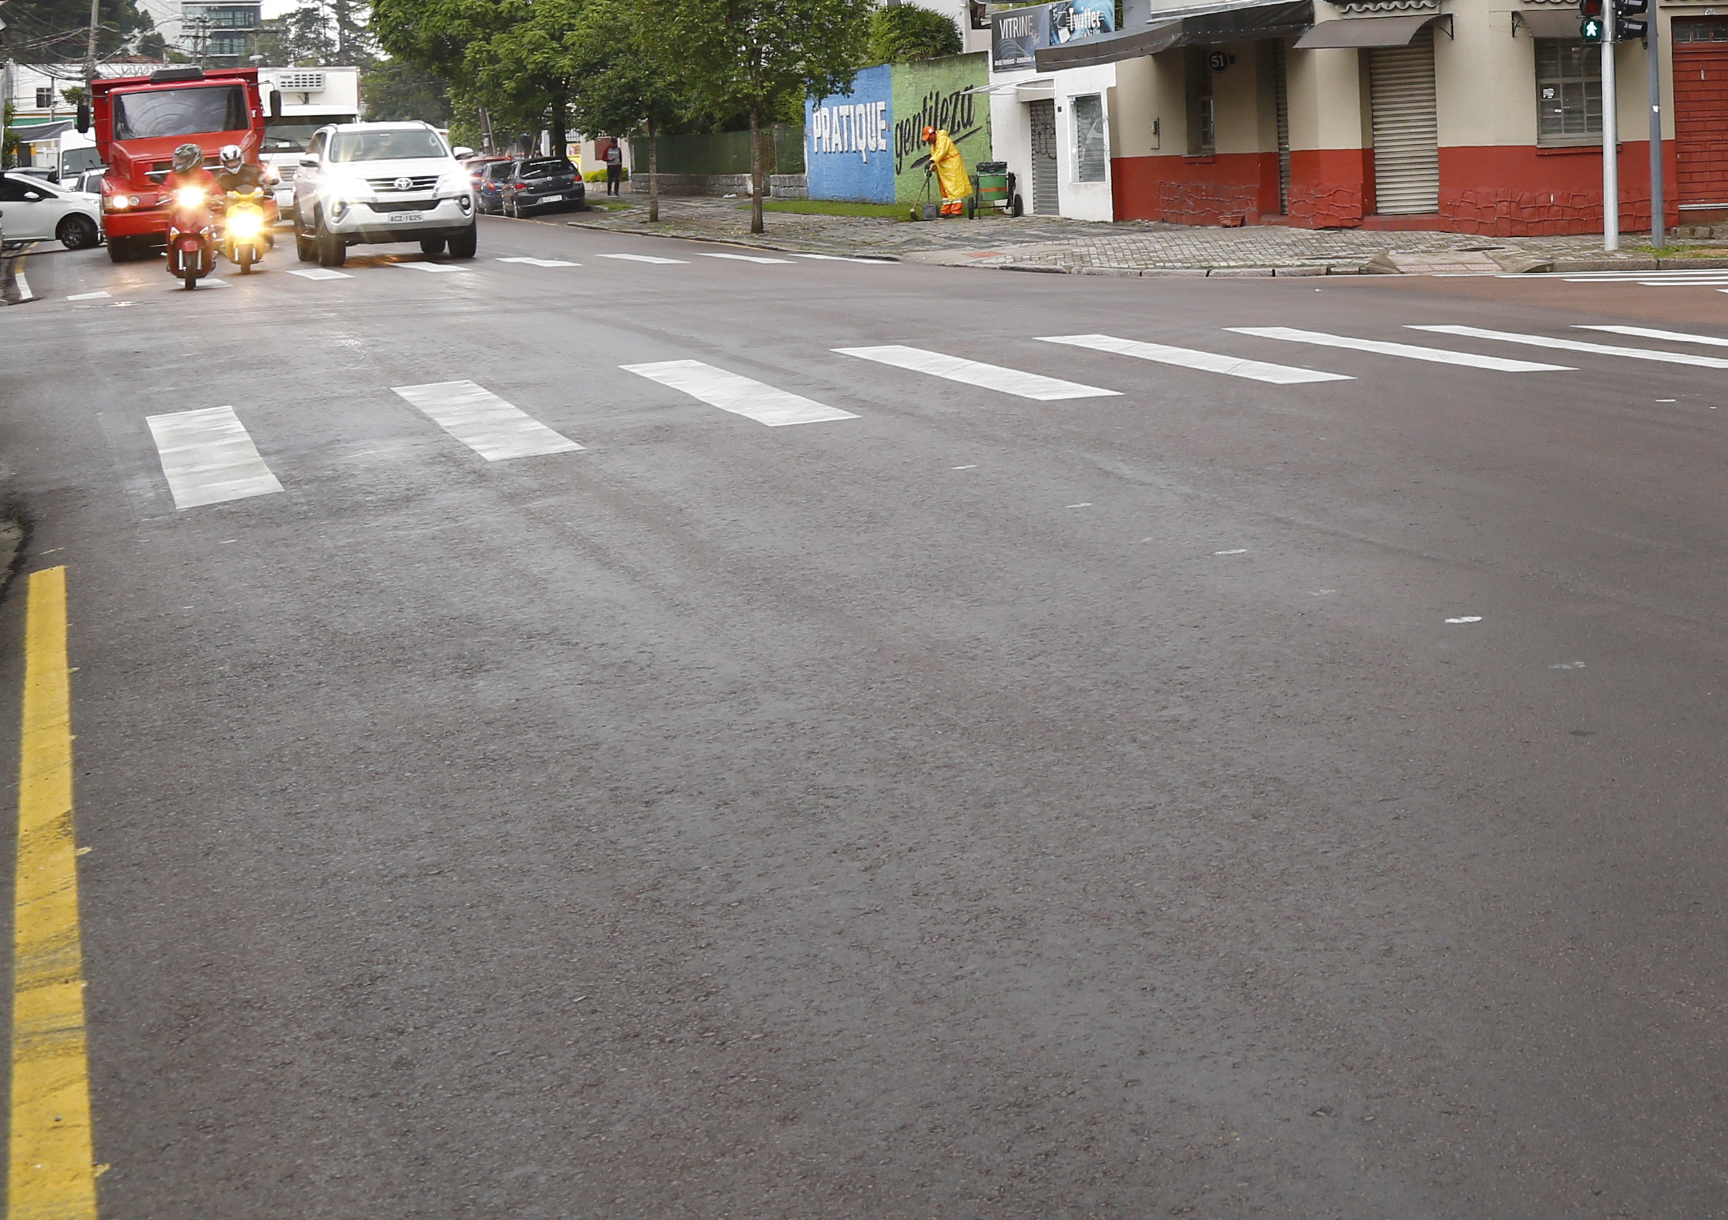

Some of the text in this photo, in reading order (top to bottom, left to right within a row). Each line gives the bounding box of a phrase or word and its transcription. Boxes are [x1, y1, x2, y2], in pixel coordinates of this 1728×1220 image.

[999, 14, 1034, 39] VITRINE
[1211, 55, 1225, 68] 51
[812, 101, 887, 164] PRATIQUE
[895, 84, 975, 175] gentileza
